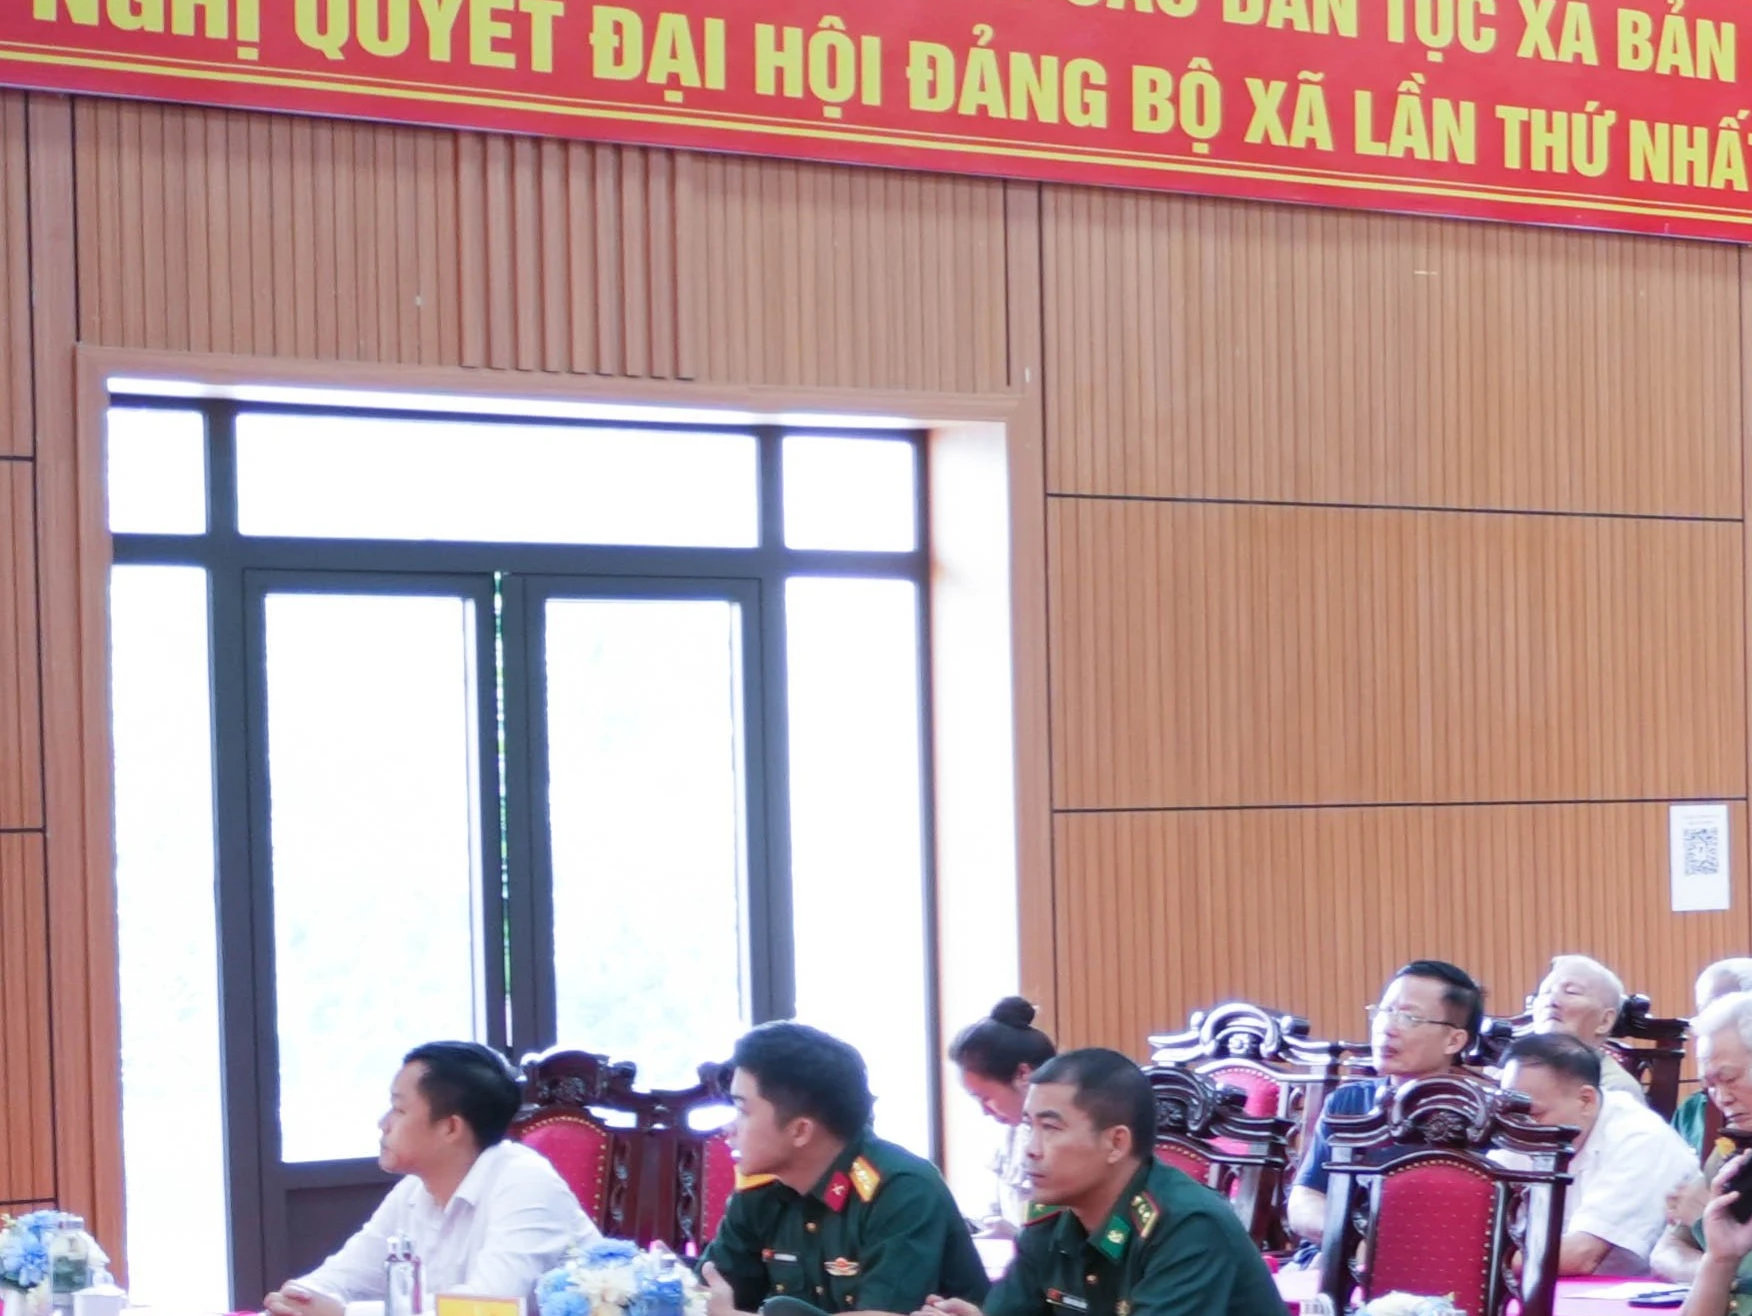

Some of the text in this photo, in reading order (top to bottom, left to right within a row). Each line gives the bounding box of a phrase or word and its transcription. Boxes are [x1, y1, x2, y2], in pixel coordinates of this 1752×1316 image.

[590, 6, 724, 101] ĐẠI
[756, 15, 880, 117] HỘI
[908, 24, 1106, 125] ĐẢNG
[1133, 58, 1221, 153] BỘ
[1246, 70, 1332, 149] XÃ
[1356, 72, 1475, 162] LẦN
[1497, 99, 1618, 176] THỨ
